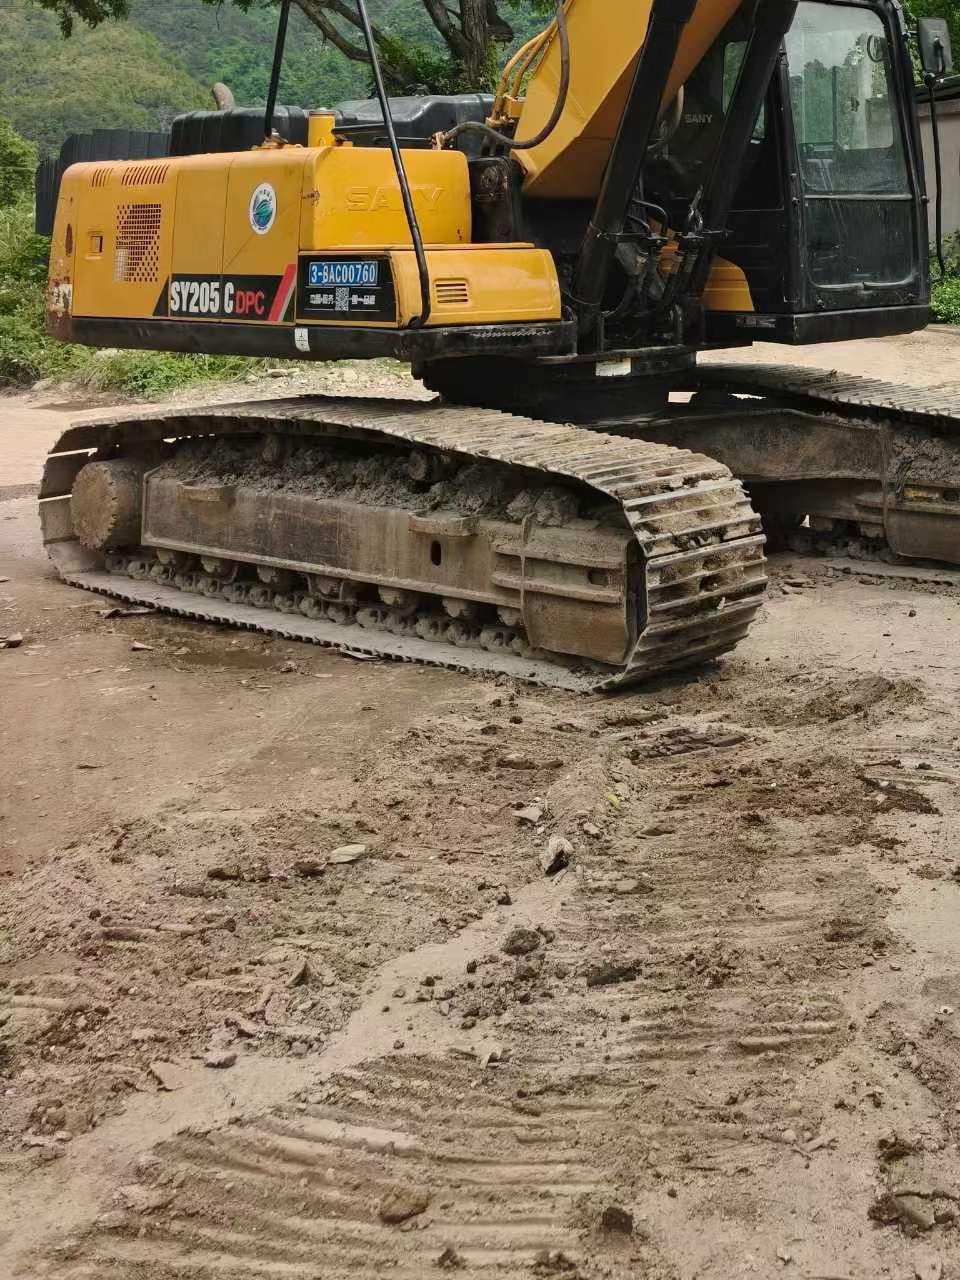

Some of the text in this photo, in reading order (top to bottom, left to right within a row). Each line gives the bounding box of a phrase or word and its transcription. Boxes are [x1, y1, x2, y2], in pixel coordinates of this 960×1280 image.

[345, 185, 444, 211] SAY
[311, 264, 376, 284] 3-BAC00760
[236, 290, 265, 315] DPC
